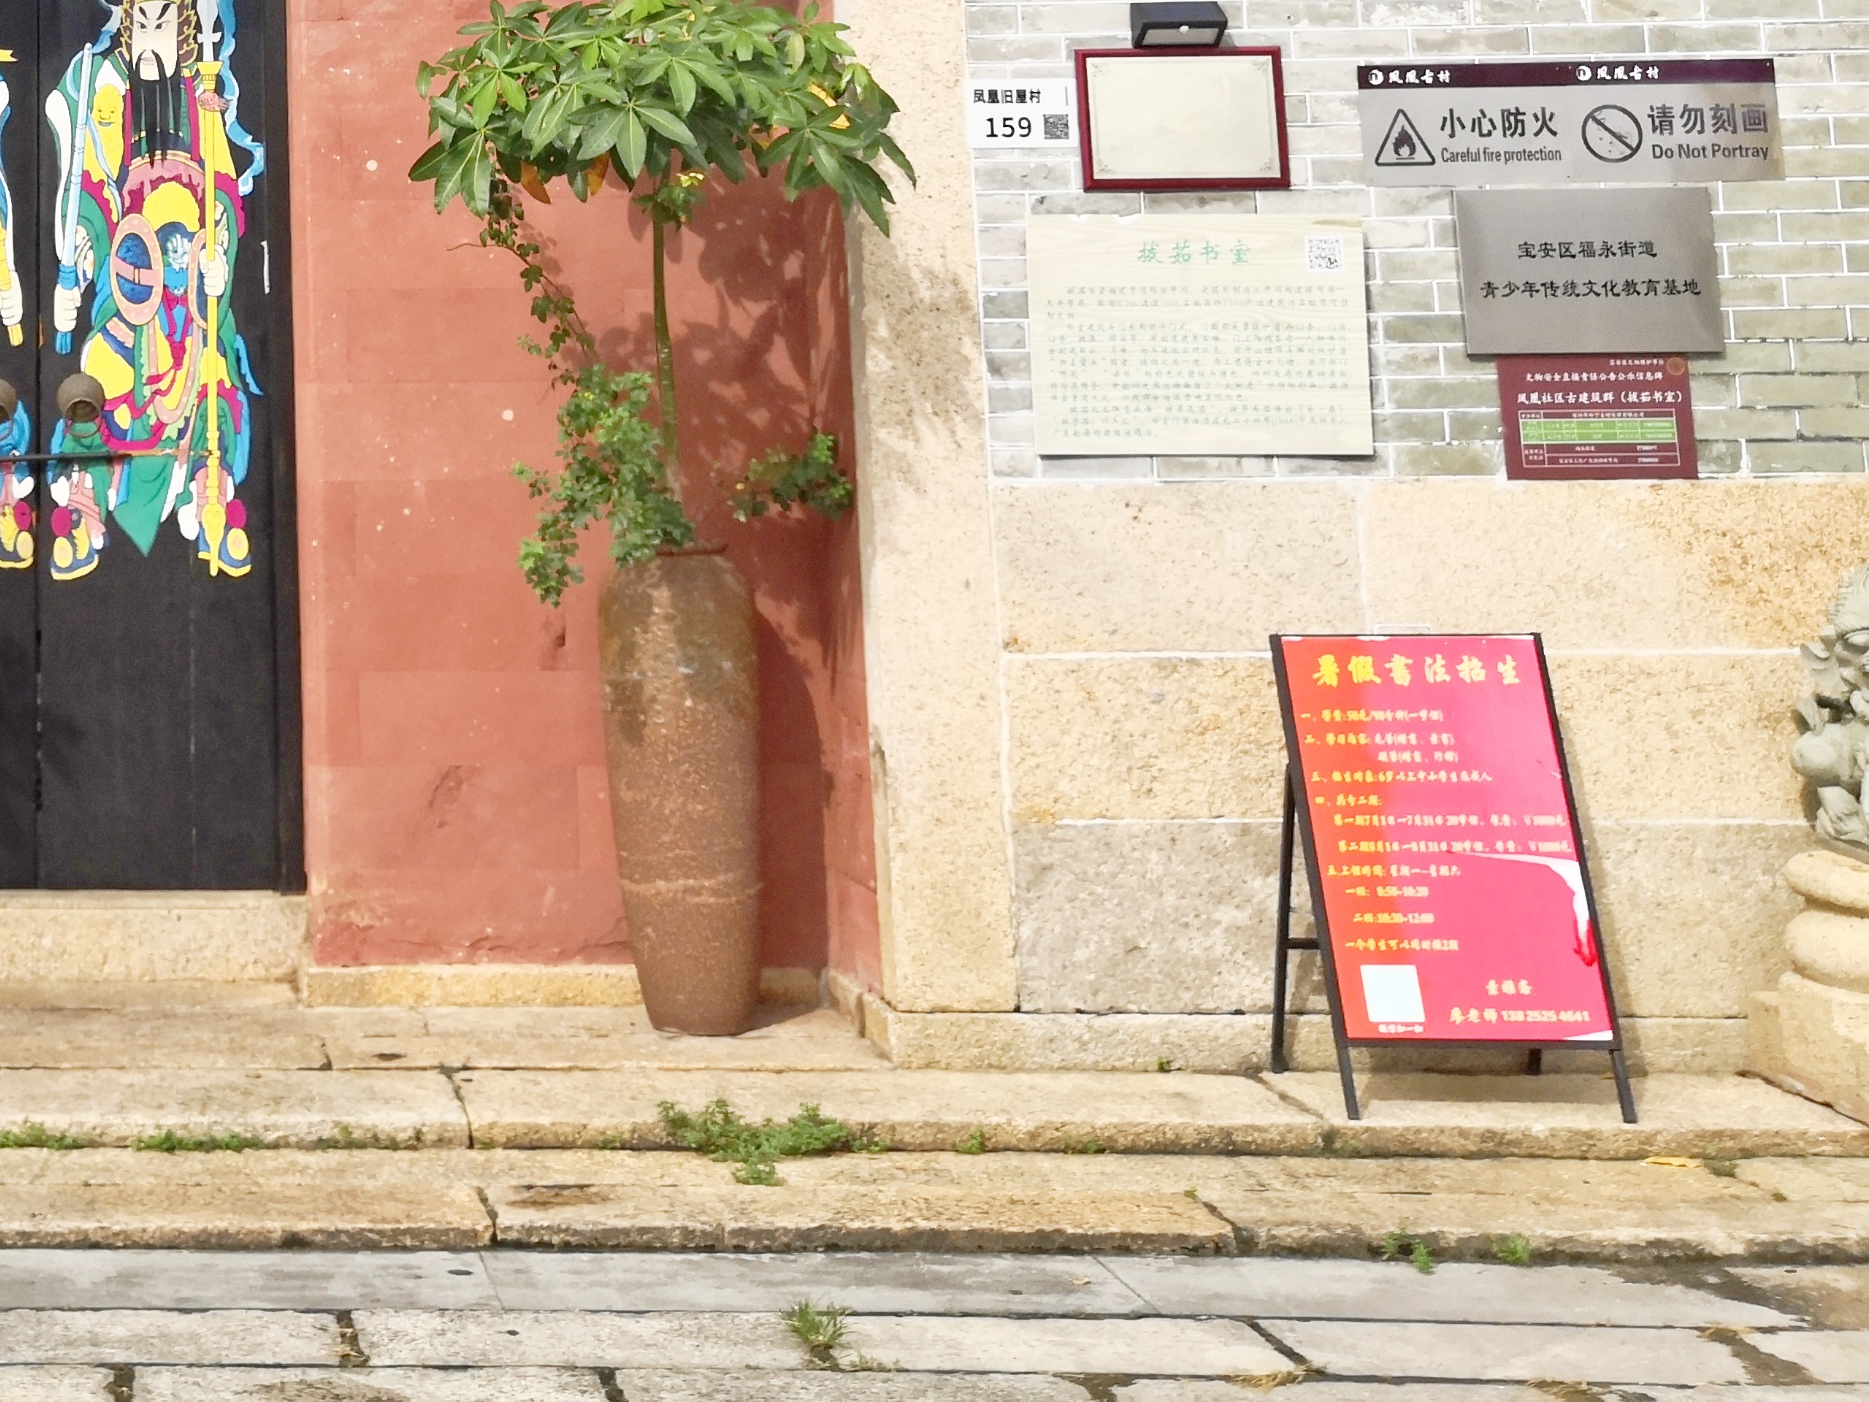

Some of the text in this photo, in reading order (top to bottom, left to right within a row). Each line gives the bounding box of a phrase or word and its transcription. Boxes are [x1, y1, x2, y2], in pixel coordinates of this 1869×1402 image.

[1388, 69, 1450, 84] 凤凰古村
[1596, 65, 1659, 80] 凤凰古村
[973, 88, 1041, 104] 凤凰旧屋村
[986, 117, 1032, 138] 159
[1440, 106, 1559, 139] 小心防火
[1647, 103, 1768, 136] 请勿刻画
[1441, 145, 1562, 165] Careful fire protection
[1652, 142, 1769, 161] Do Not Portray
[1137, 239, 1250, 264] 拔茹书室
[1518, 240, 1658, 259] 宝安区福永街道
[1480, 279, 1701, 299] 青少年传统文化教育基地
